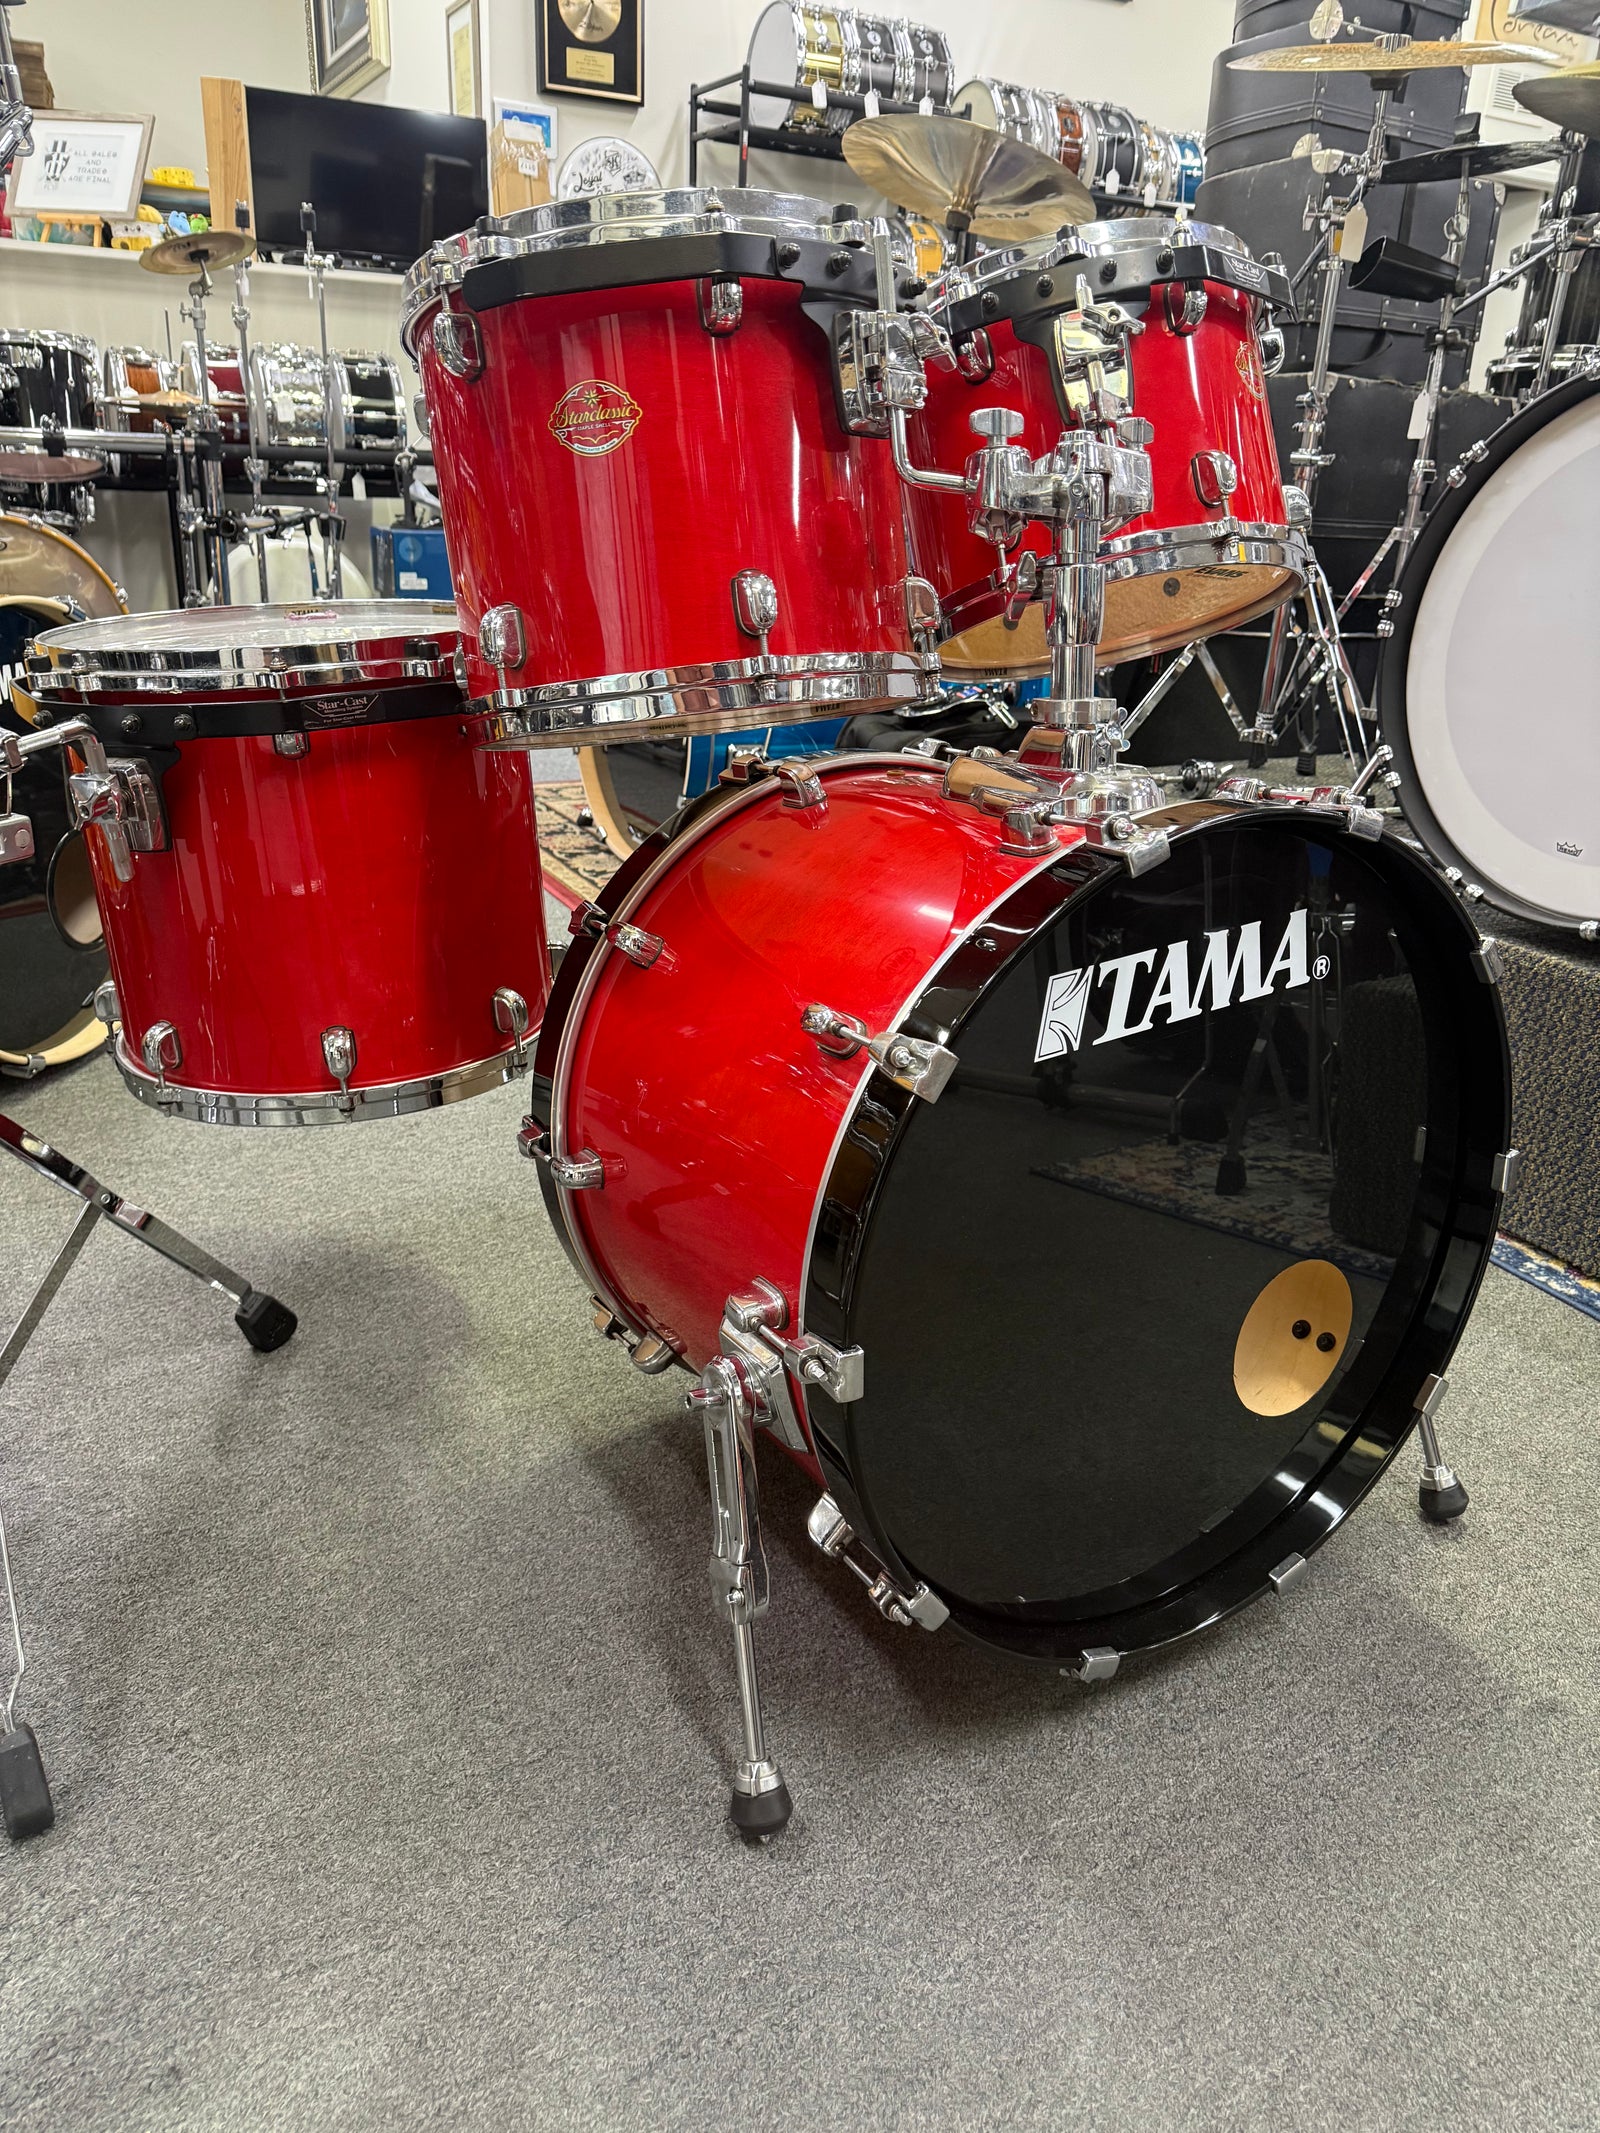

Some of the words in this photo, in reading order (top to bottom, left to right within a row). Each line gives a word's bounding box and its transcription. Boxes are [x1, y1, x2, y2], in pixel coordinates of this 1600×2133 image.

[92, 150, 118, 158] SALES
[77, 166, 108, 175] TRADES
[86, 176, 111, 184] FINAL
[554, 402, 635, 428] Starclassic
[316, 696, 368, 711] Star-Cast
